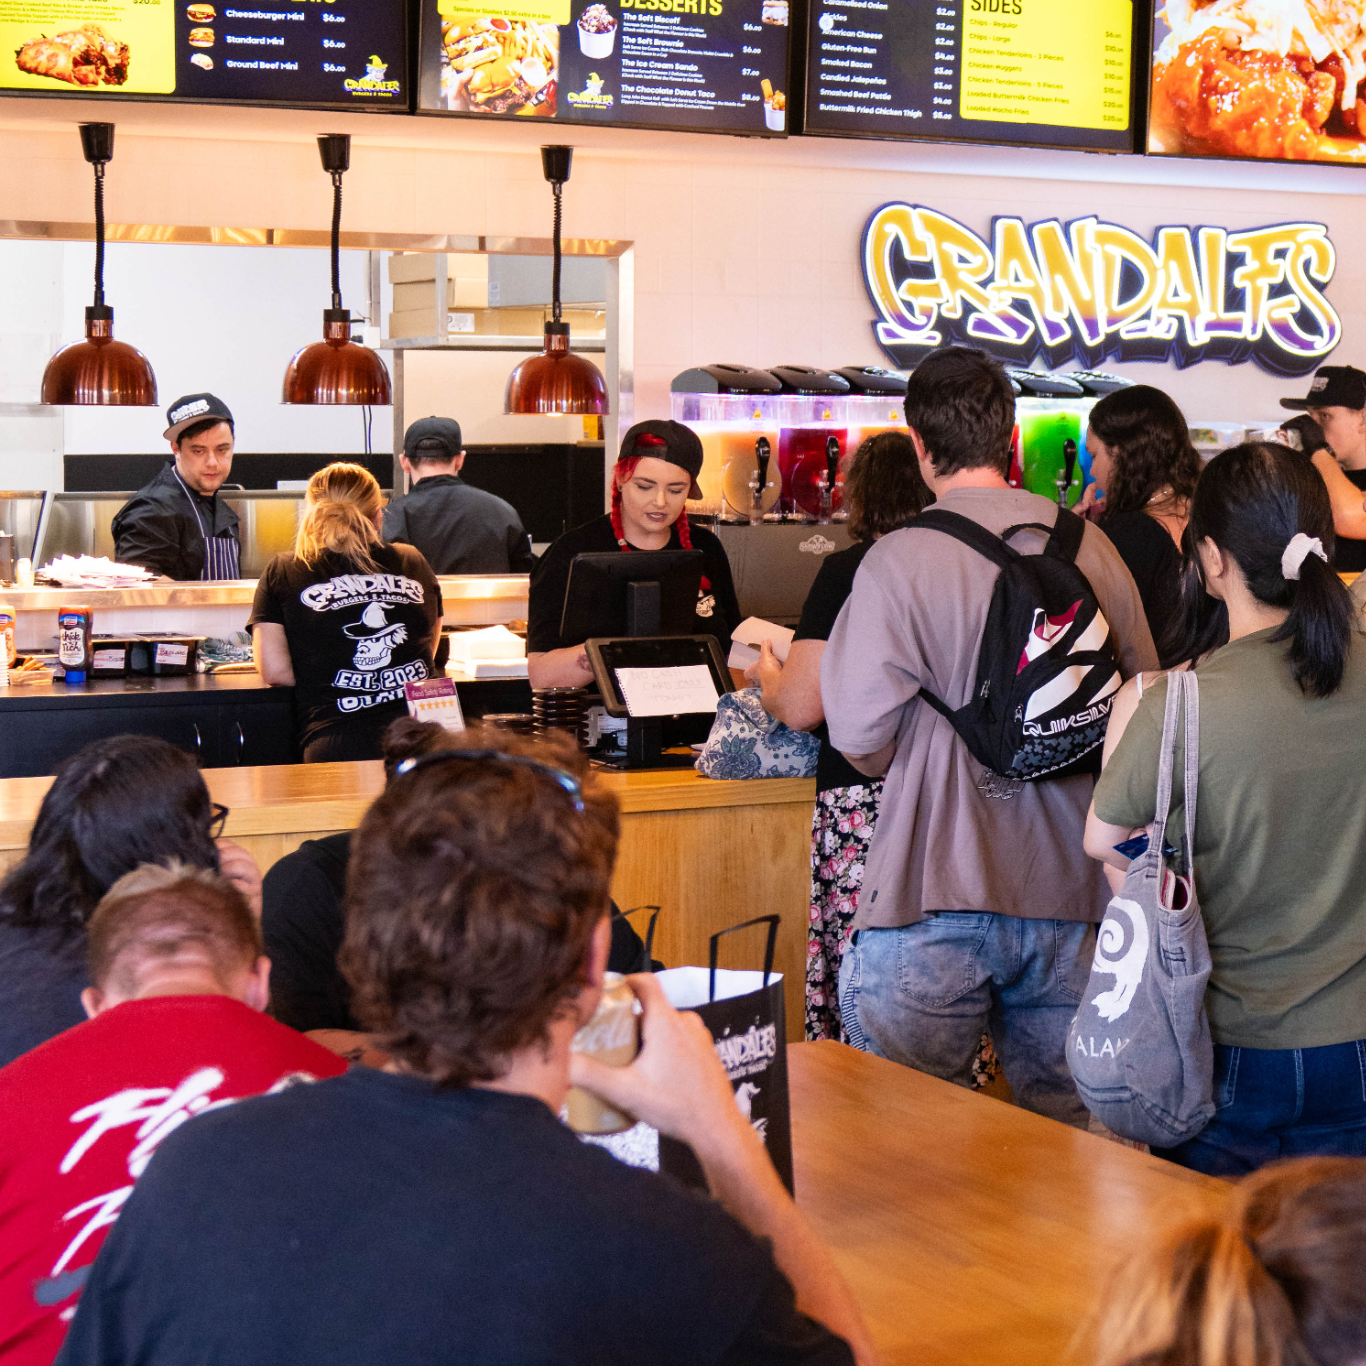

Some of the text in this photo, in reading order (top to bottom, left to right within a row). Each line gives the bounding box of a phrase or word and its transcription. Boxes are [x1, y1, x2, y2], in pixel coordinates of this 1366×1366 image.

[226, 9, 304, 21] Cheeseburger Mini
[322, 13, 345, 23] $6.00
[638, 14, 653, 22] Soft
[226, 36, 284, 45] Standard Mini
[322, 39, 345, 48] $6.00
[637, 37, 652, 45] Soft
[654, 39, 684, 47] Brownie
[227, 60, 257, 69] Ground
[281, 62, 298, 70] Mini
[323, 63, 346, 72] $6.00
[622, 58, 635, 66] The
[650, 61, 674, 69] Cream
[636, 86, 673, 95] Chocolate
[675, 88, 696, 96] Donut
[698, 90, 715, 98] Taco
[866, 204, 1341, 355] GRANDALFS
[332, 595, 368, 608] BURGERS
[380, 594, 408, 602] TACOS
[336, 659, 428, 691] EST. 2023
